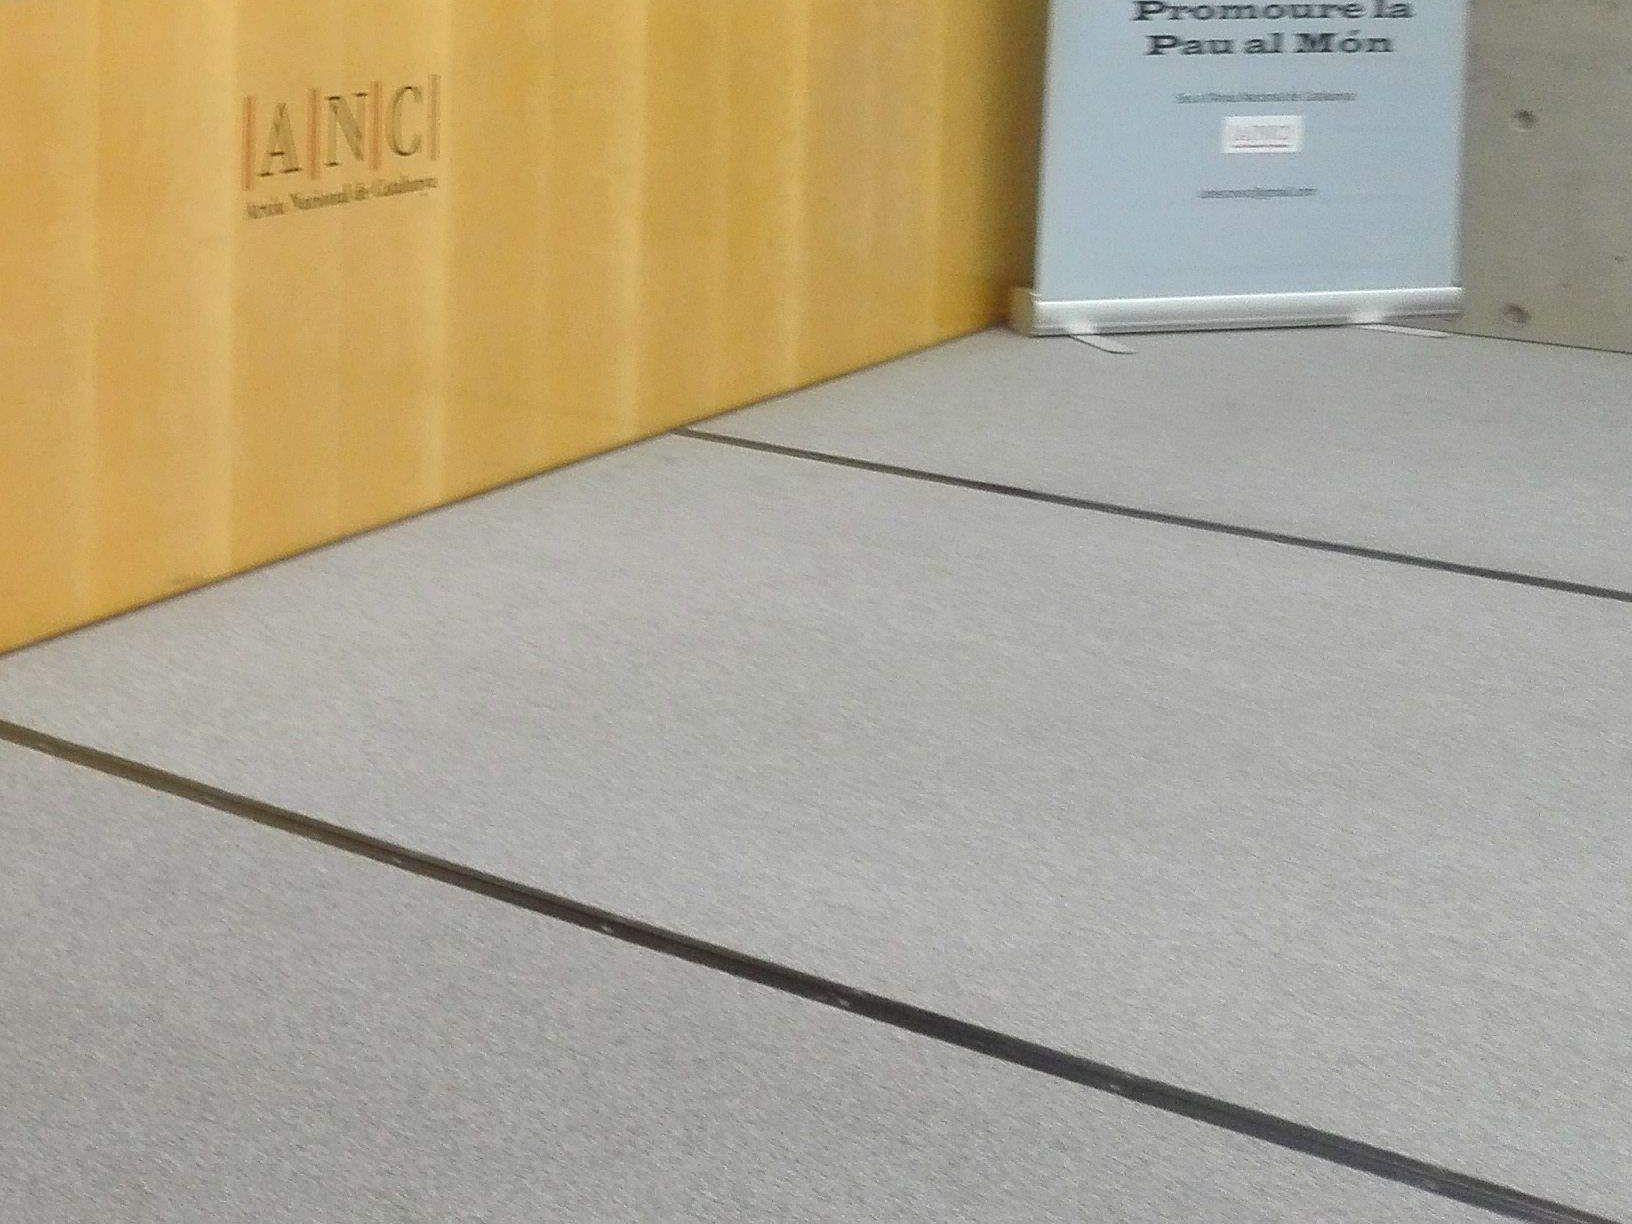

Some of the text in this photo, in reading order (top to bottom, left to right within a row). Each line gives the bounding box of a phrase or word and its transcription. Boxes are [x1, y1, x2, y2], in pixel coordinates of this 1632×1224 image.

[1130, 0, 1366, 22] Promoure
[1143, 28, 1395, 56] Pau al Món
